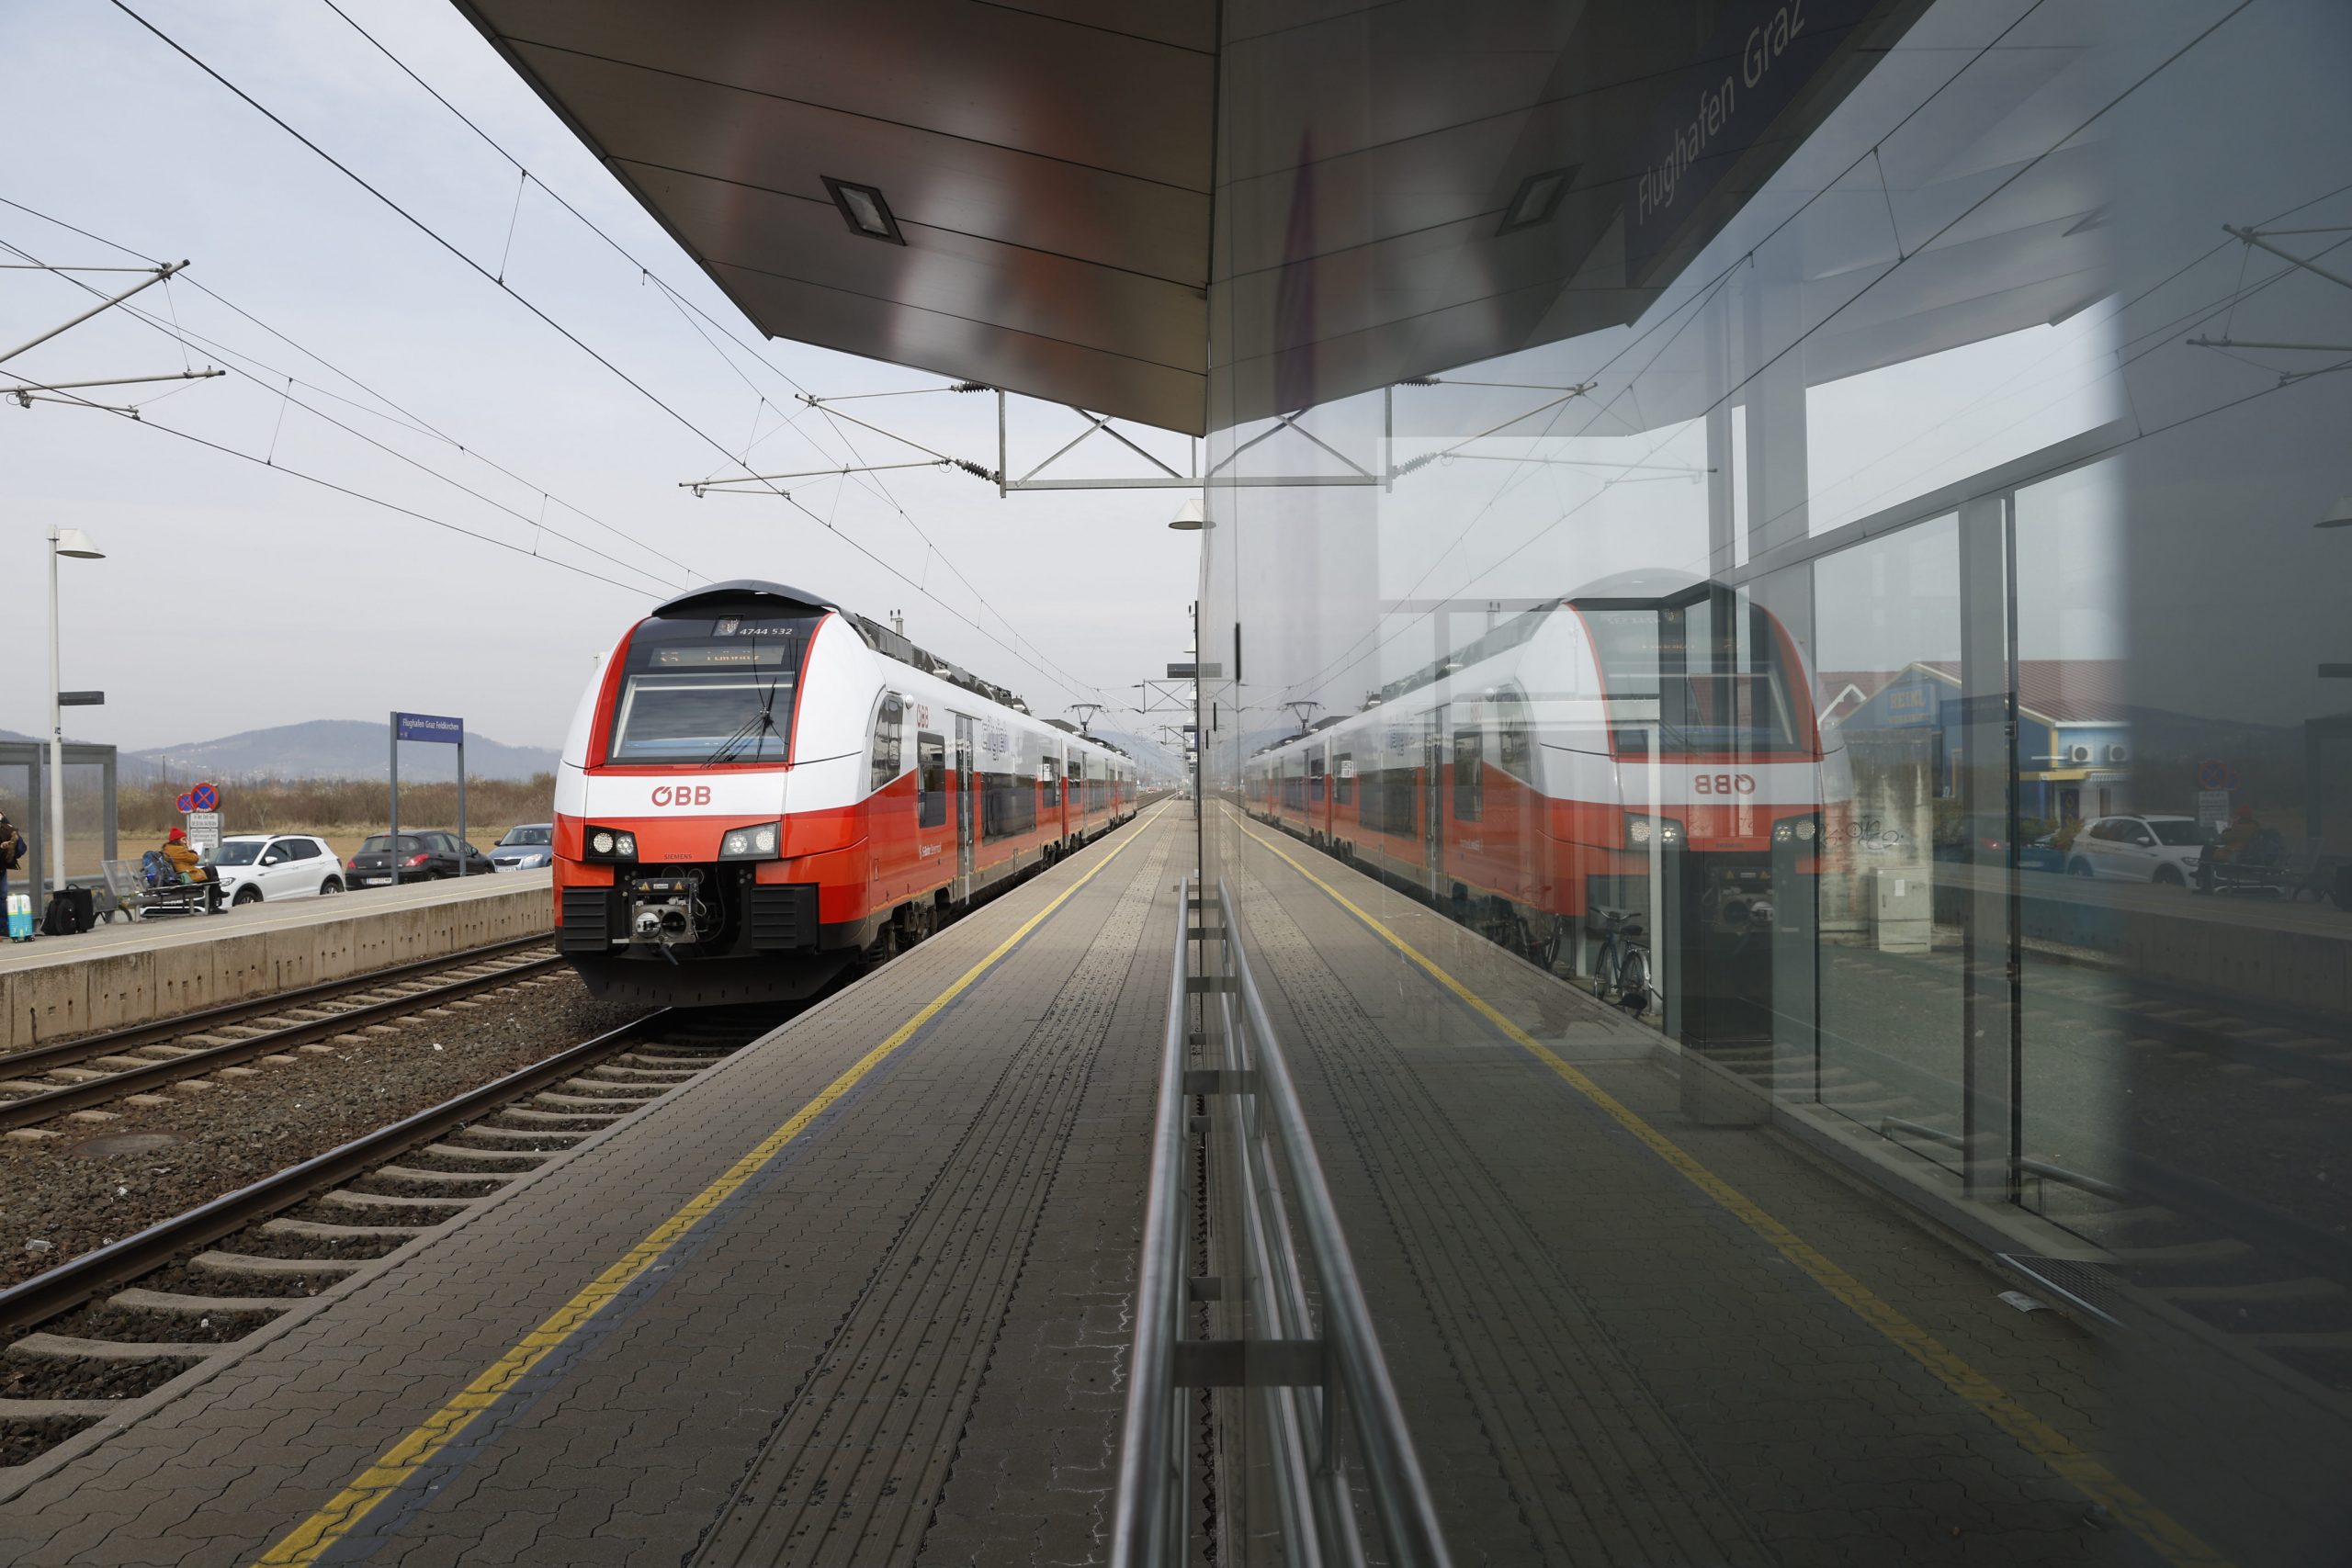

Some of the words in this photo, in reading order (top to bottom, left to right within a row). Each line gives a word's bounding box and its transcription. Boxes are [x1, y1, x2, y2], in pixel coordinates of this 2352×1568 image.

[1638, 74, 1735, 225] Flughafen
[1744, 0, 1805, 89] Graz
[402, 718, 424, 728] Flughafen
[425, 720, 435, 729] Graz
[435, 721, 459, 731] Feldkirchen
[651, 785, 711, 807] ÖBB
